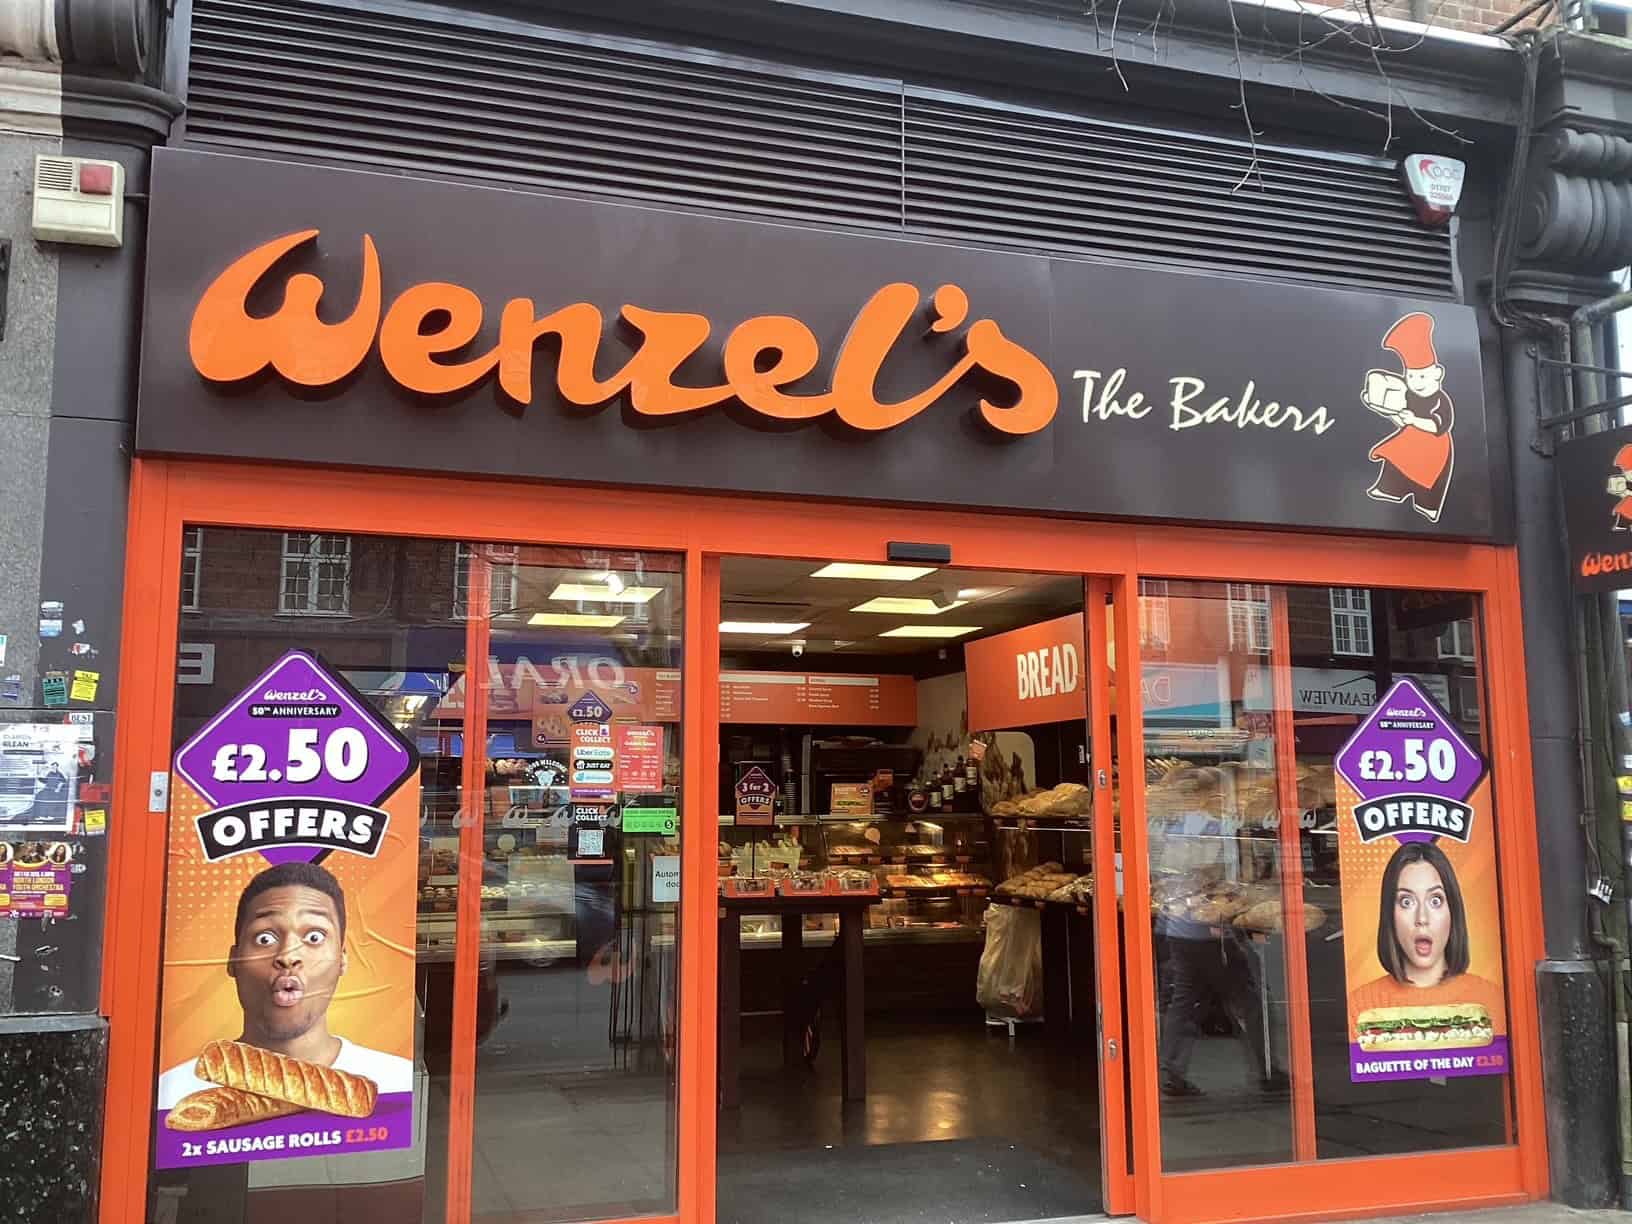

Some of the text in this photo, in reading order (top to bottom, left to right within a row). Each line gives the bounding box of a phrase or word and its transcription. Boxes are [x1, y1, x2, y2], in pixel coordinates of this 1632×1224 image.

[188, 227, 1058, 434] Wenzel's
[1072, 368, 1335, 435] The Bakers
[1016, 643, 1078, 700] BREAD
[264, 688, 327, 701] Wenzel's
[272, 706, 338, 716] ANNIVERSARY
[1386, 707, 1427, 718] Wenzel's
[1393, 721, 1434, 729] ANNIVERSARY
[211, 726, 369, 783] £2.50
[1358, 738, 1456, 782] £2.50
[742, 782, 748, 792] 3
[763, 782, 769, 792] 2
[576, 807, 598, 815] CLICK
[740, 796, 770, 804] OFFERS
[212, 806, 374, 847] OFFERS
[1364, 802, 1465, 832] OFFERS
[1356, 1060, 1412, 1074] BAGUETTE
[1413, 1059, 1429, 1071] OF
[1430, 1057, 1452, 1070] THE
[1453, 1056, 1474, 1069] DAY
[181, 1127, 388, 1157] 2x SAUSAGE ROLLS £2.50
